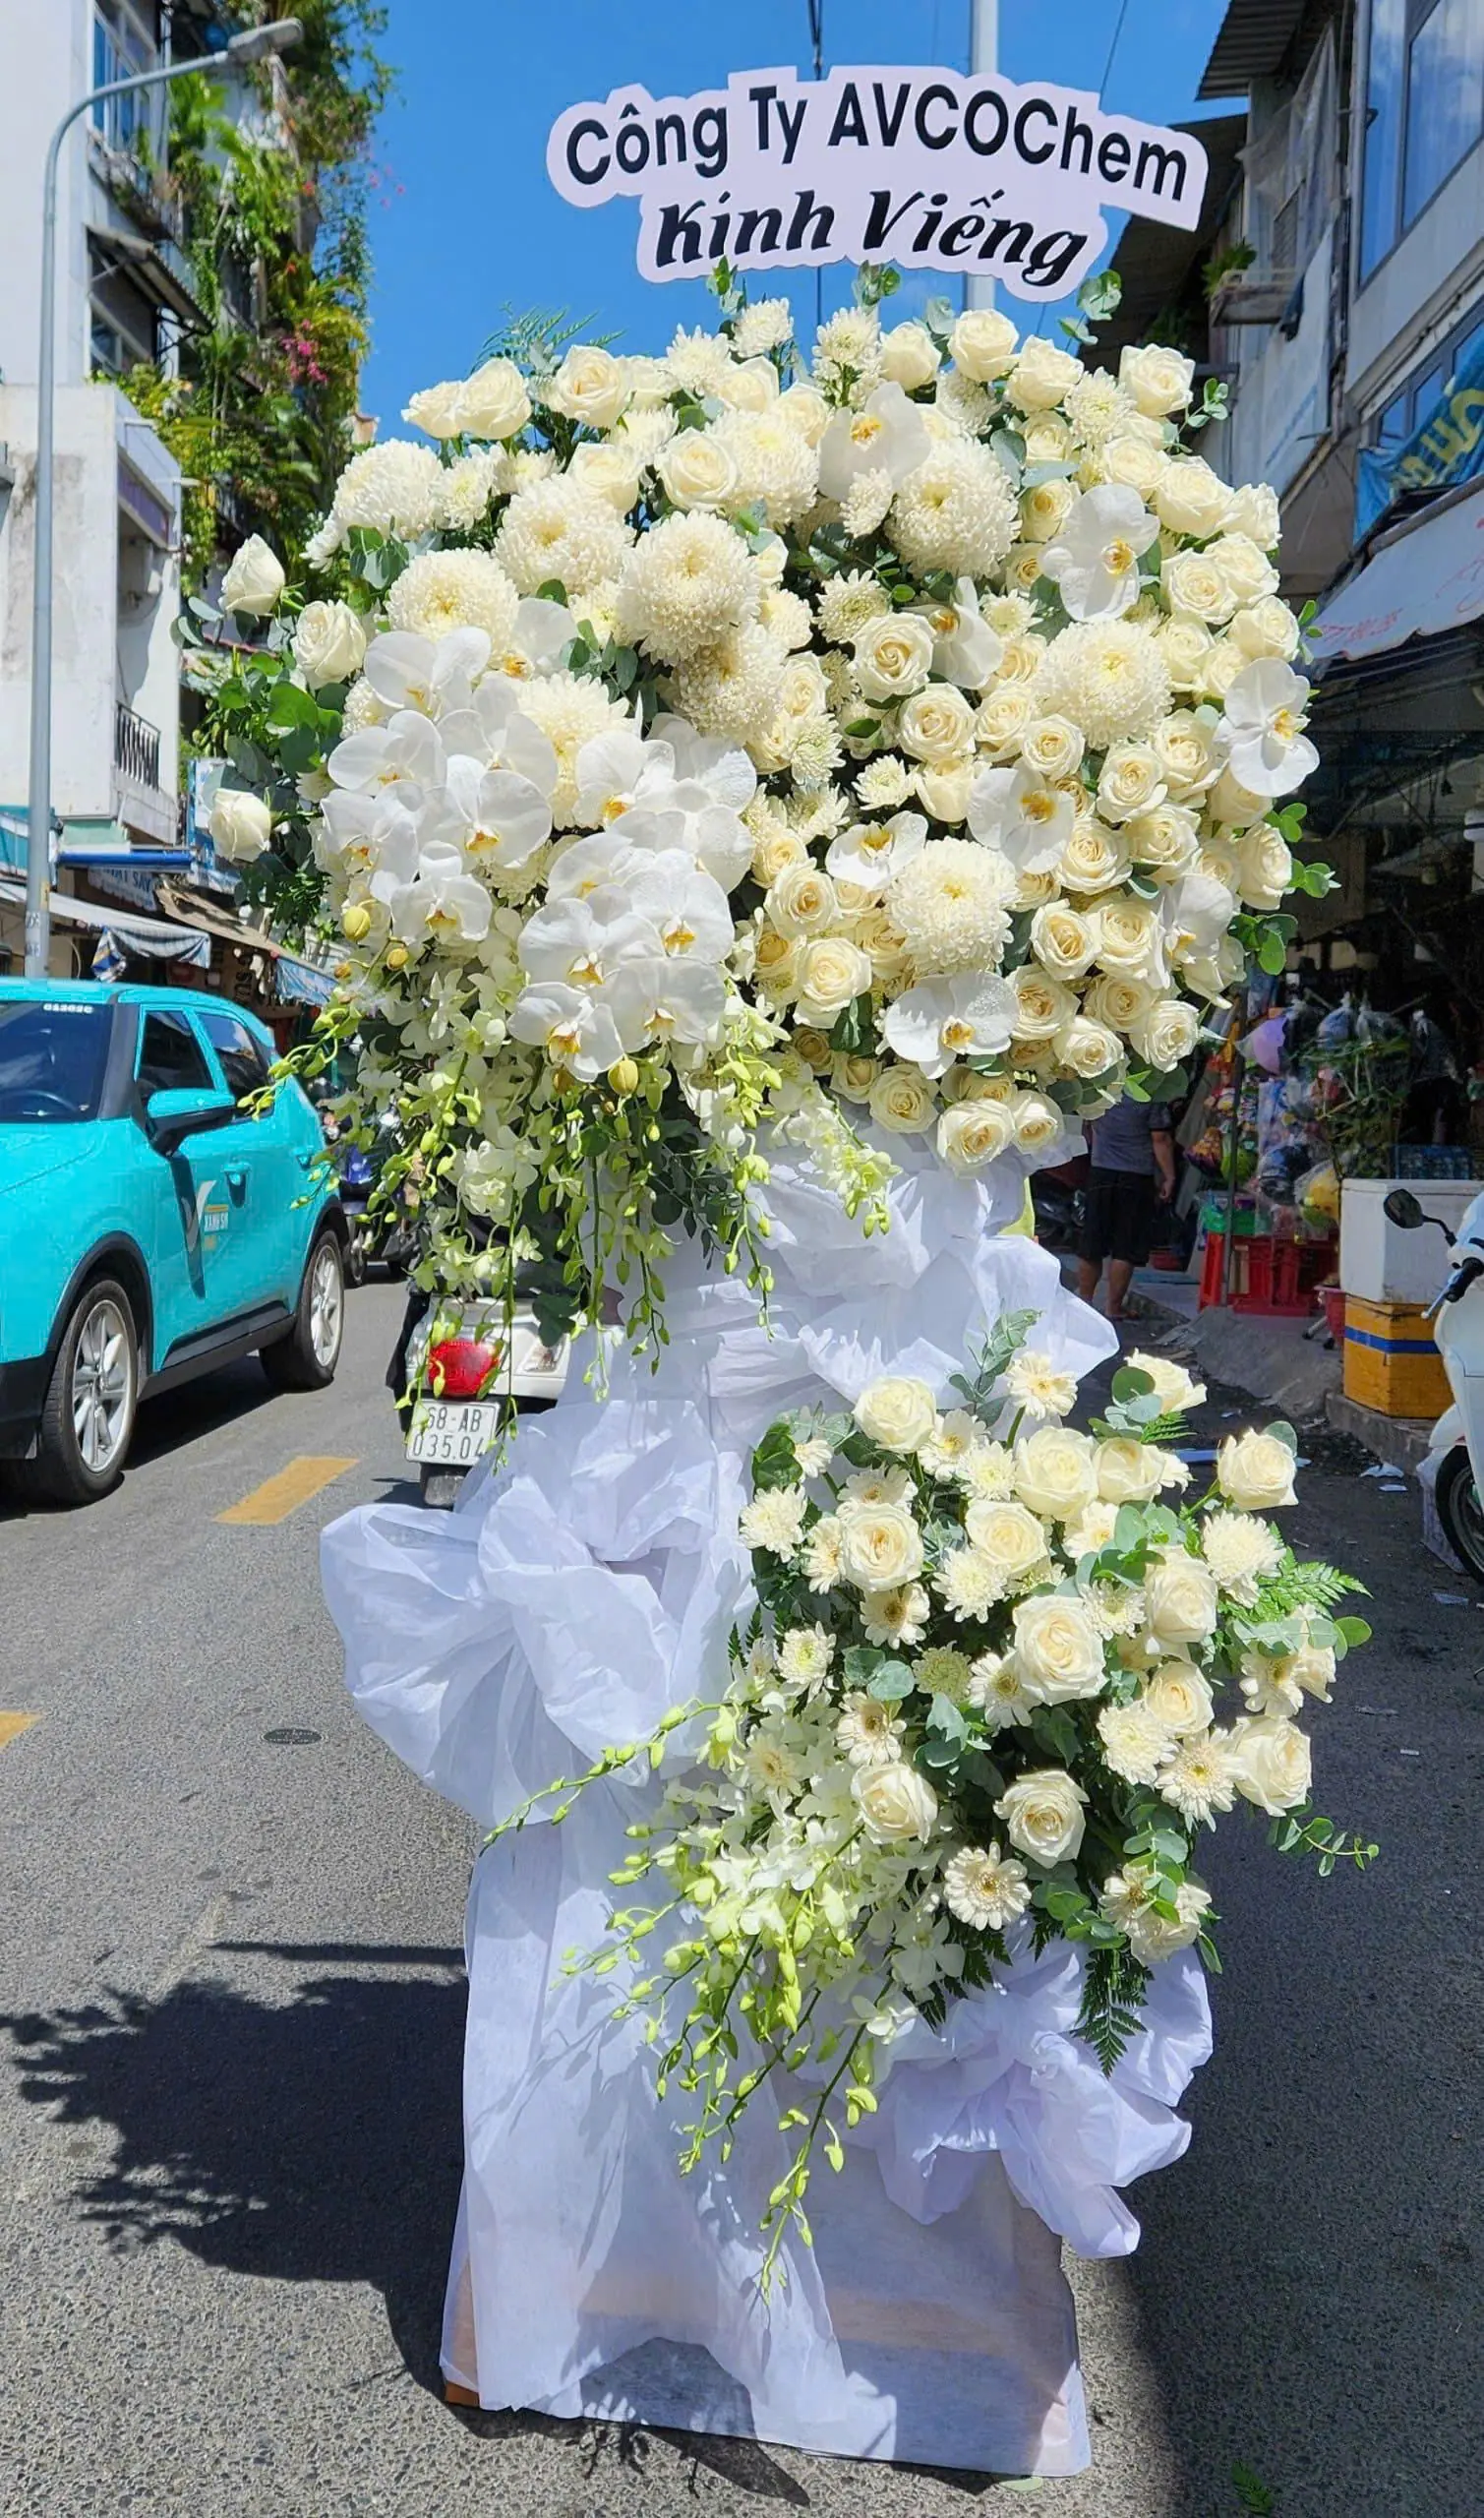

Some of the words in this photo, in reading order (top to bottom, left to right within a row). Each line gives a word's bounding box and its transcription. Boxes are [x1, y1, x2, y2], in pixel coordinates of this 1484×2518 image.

[566, 102, 728, 185] Công
[748, 86, 808, 164] Ty
[827, 82, 1187, 202] AVCOChem
[655, 190, 835, 269] Kính
[861, 188, 1089, 287] Viếng
